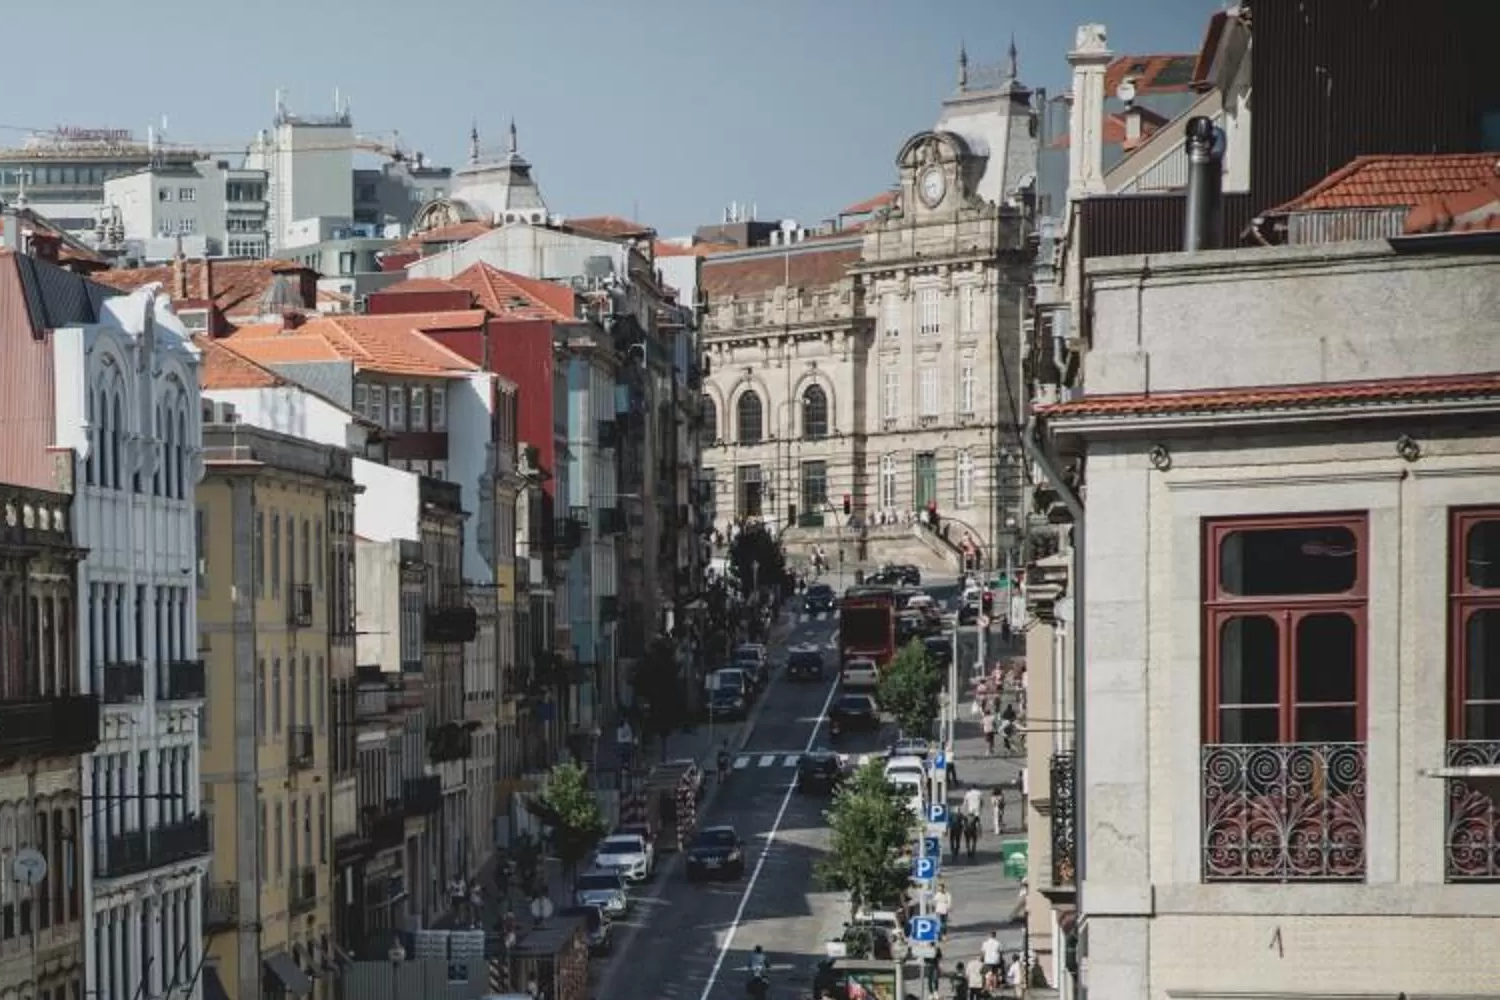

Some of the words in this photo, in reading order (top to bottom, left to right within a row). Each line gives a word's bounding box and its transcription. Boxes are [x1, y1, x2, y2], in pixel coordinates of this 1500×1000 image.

[931, 805, 943, 821] P
[917, 859, 931, 877] P
[917, 919, 931, 938] P
